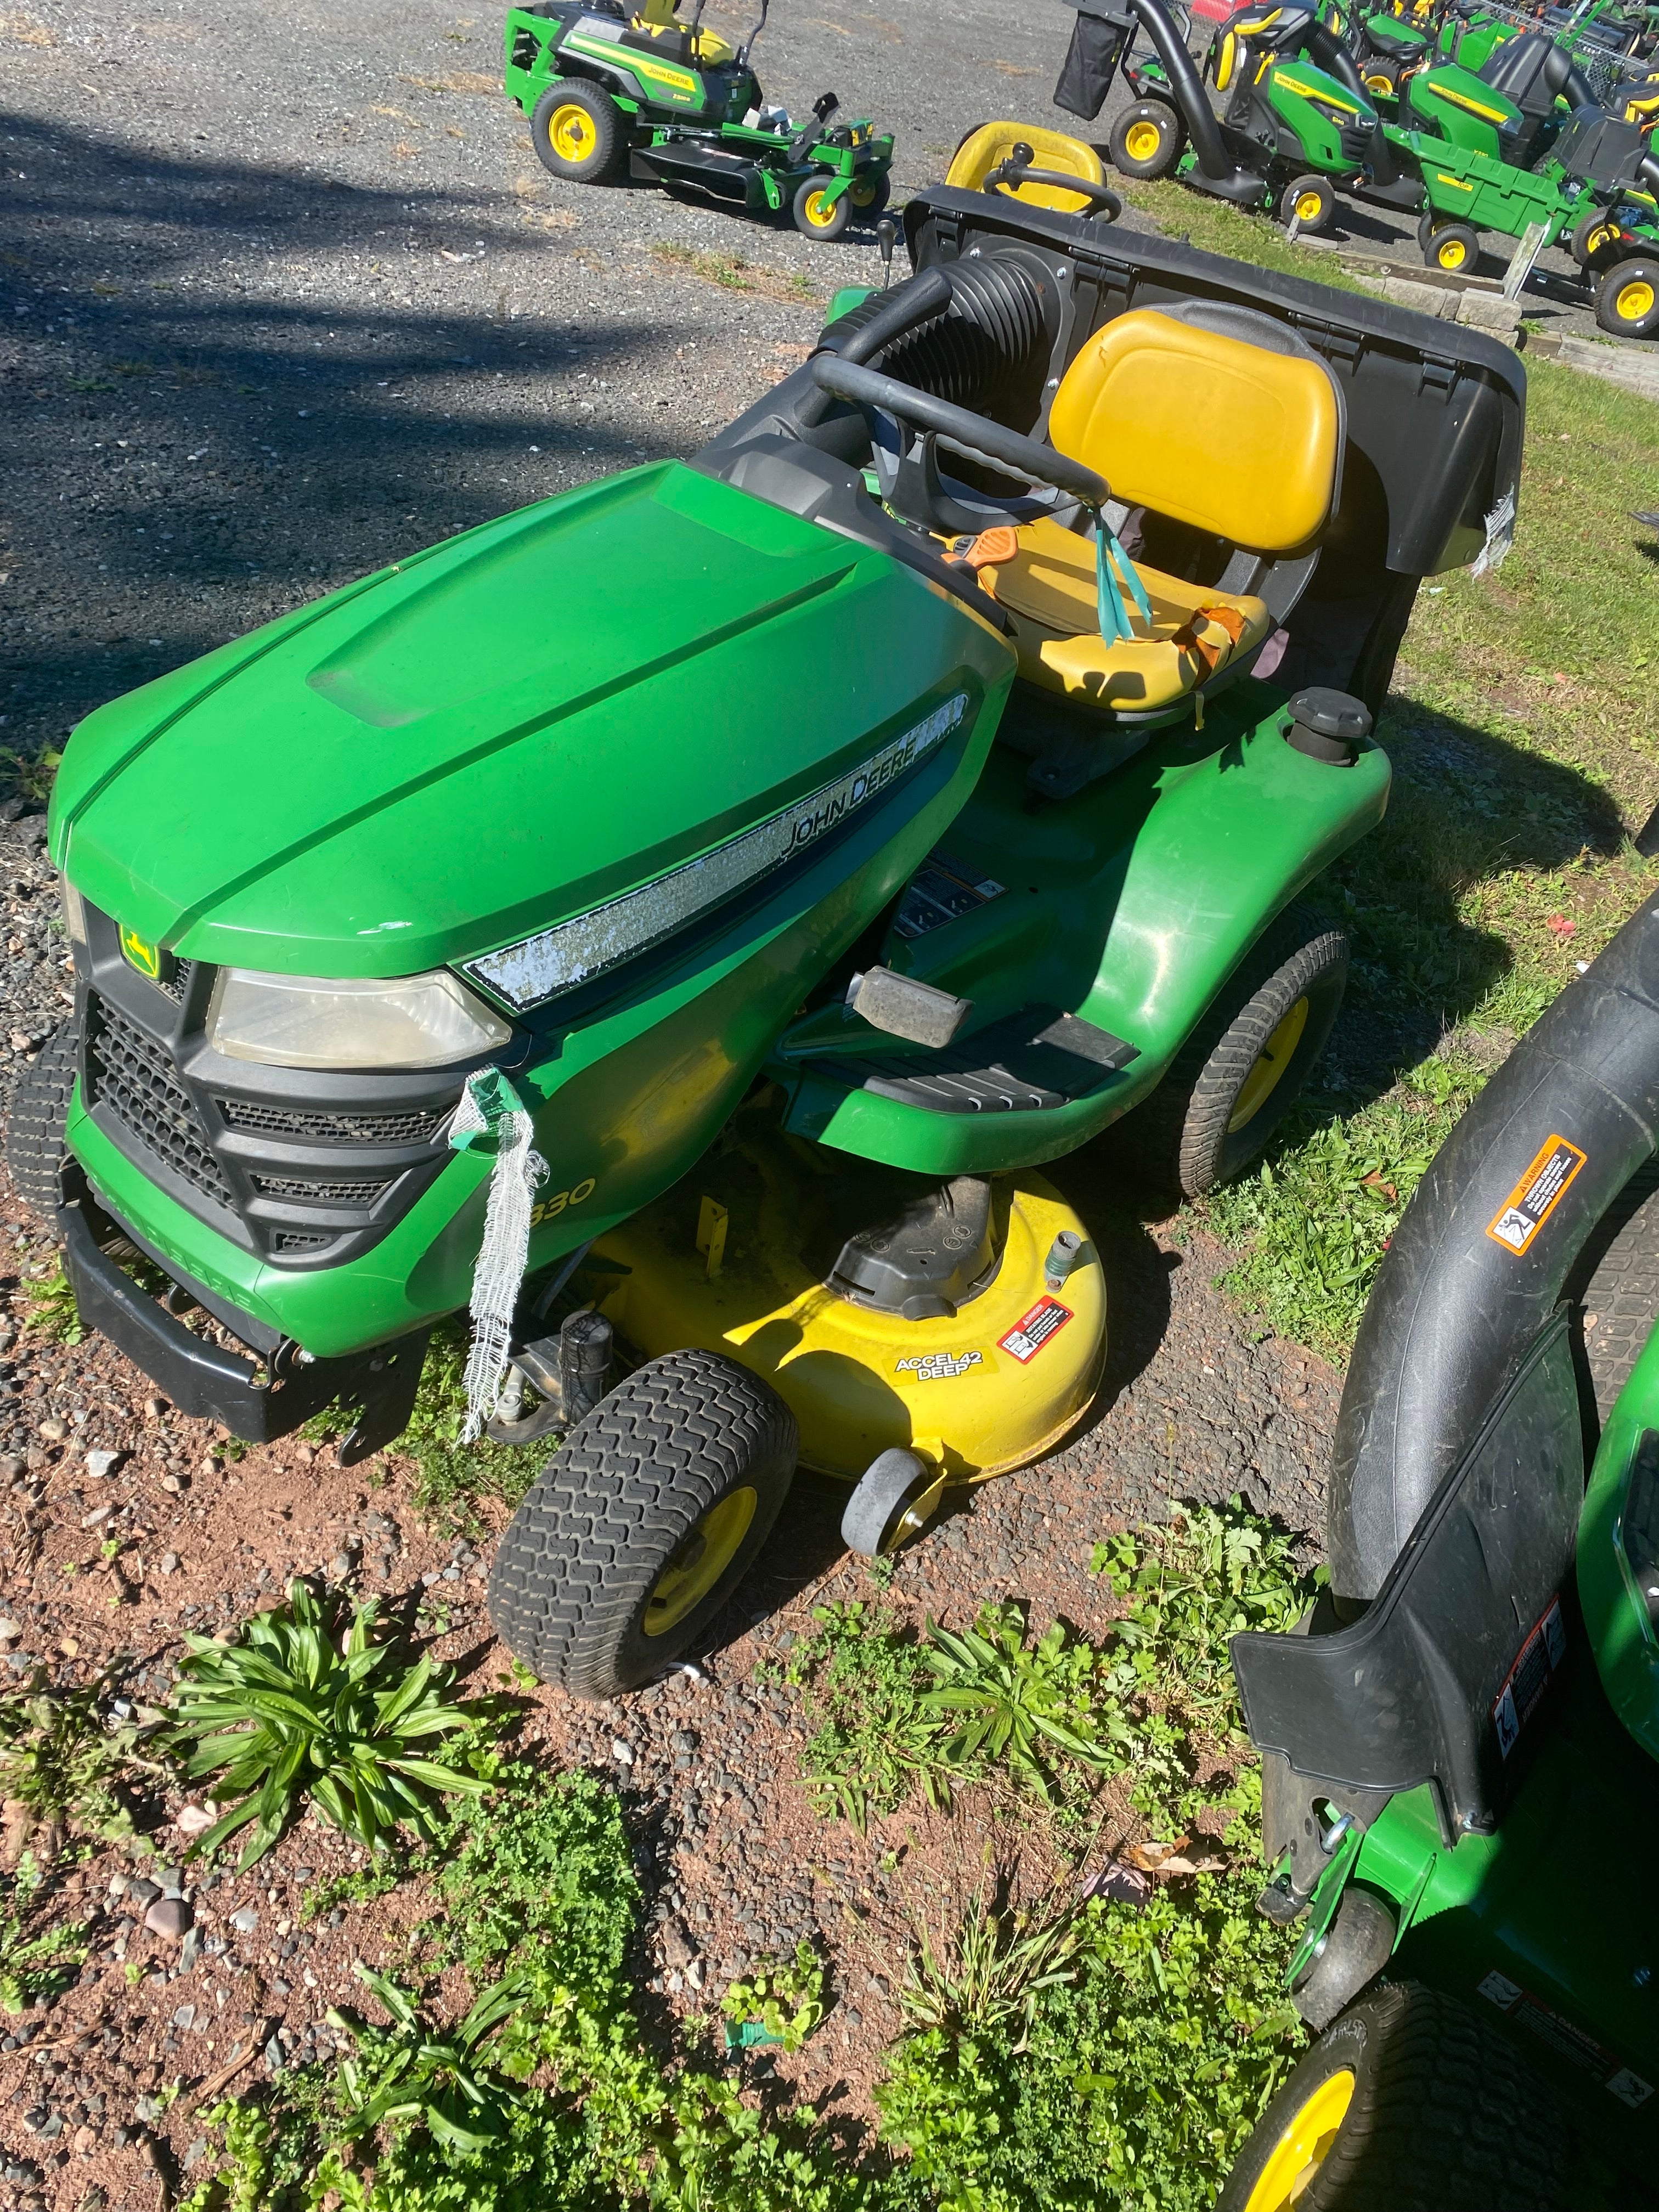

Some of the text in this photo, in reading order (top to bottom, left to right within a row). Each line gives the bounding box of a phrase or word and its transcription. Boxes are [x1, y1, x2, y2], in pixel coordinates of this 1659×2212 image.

[648, 67, 689, 85] JOHN DEERE
[1277, 76, 1307, 93] JOHN DEERE
[781, 737, 916, 855] JOHN DEERE
[1522, 1153, 1549, 1185] WARNING
[1525, 1154, 1560, 1202] THROWN OBJECTS
[1527, 1160, 1562, 1209] Do not operate mower
[1532, 1156, 1572, 1212] without chutes and hoses
[1537, 1195, 1553, 1216] securely
[1553, 1178, 1564, 1192] place
[1026, 1304, 1043, 1321] DANGER
[1026, 1307, 1052, 1333] ROTATING BLADE
[918, 1363, 969, 1381] DEEP
[1559, 2017, 1601, 2051] DANGER
